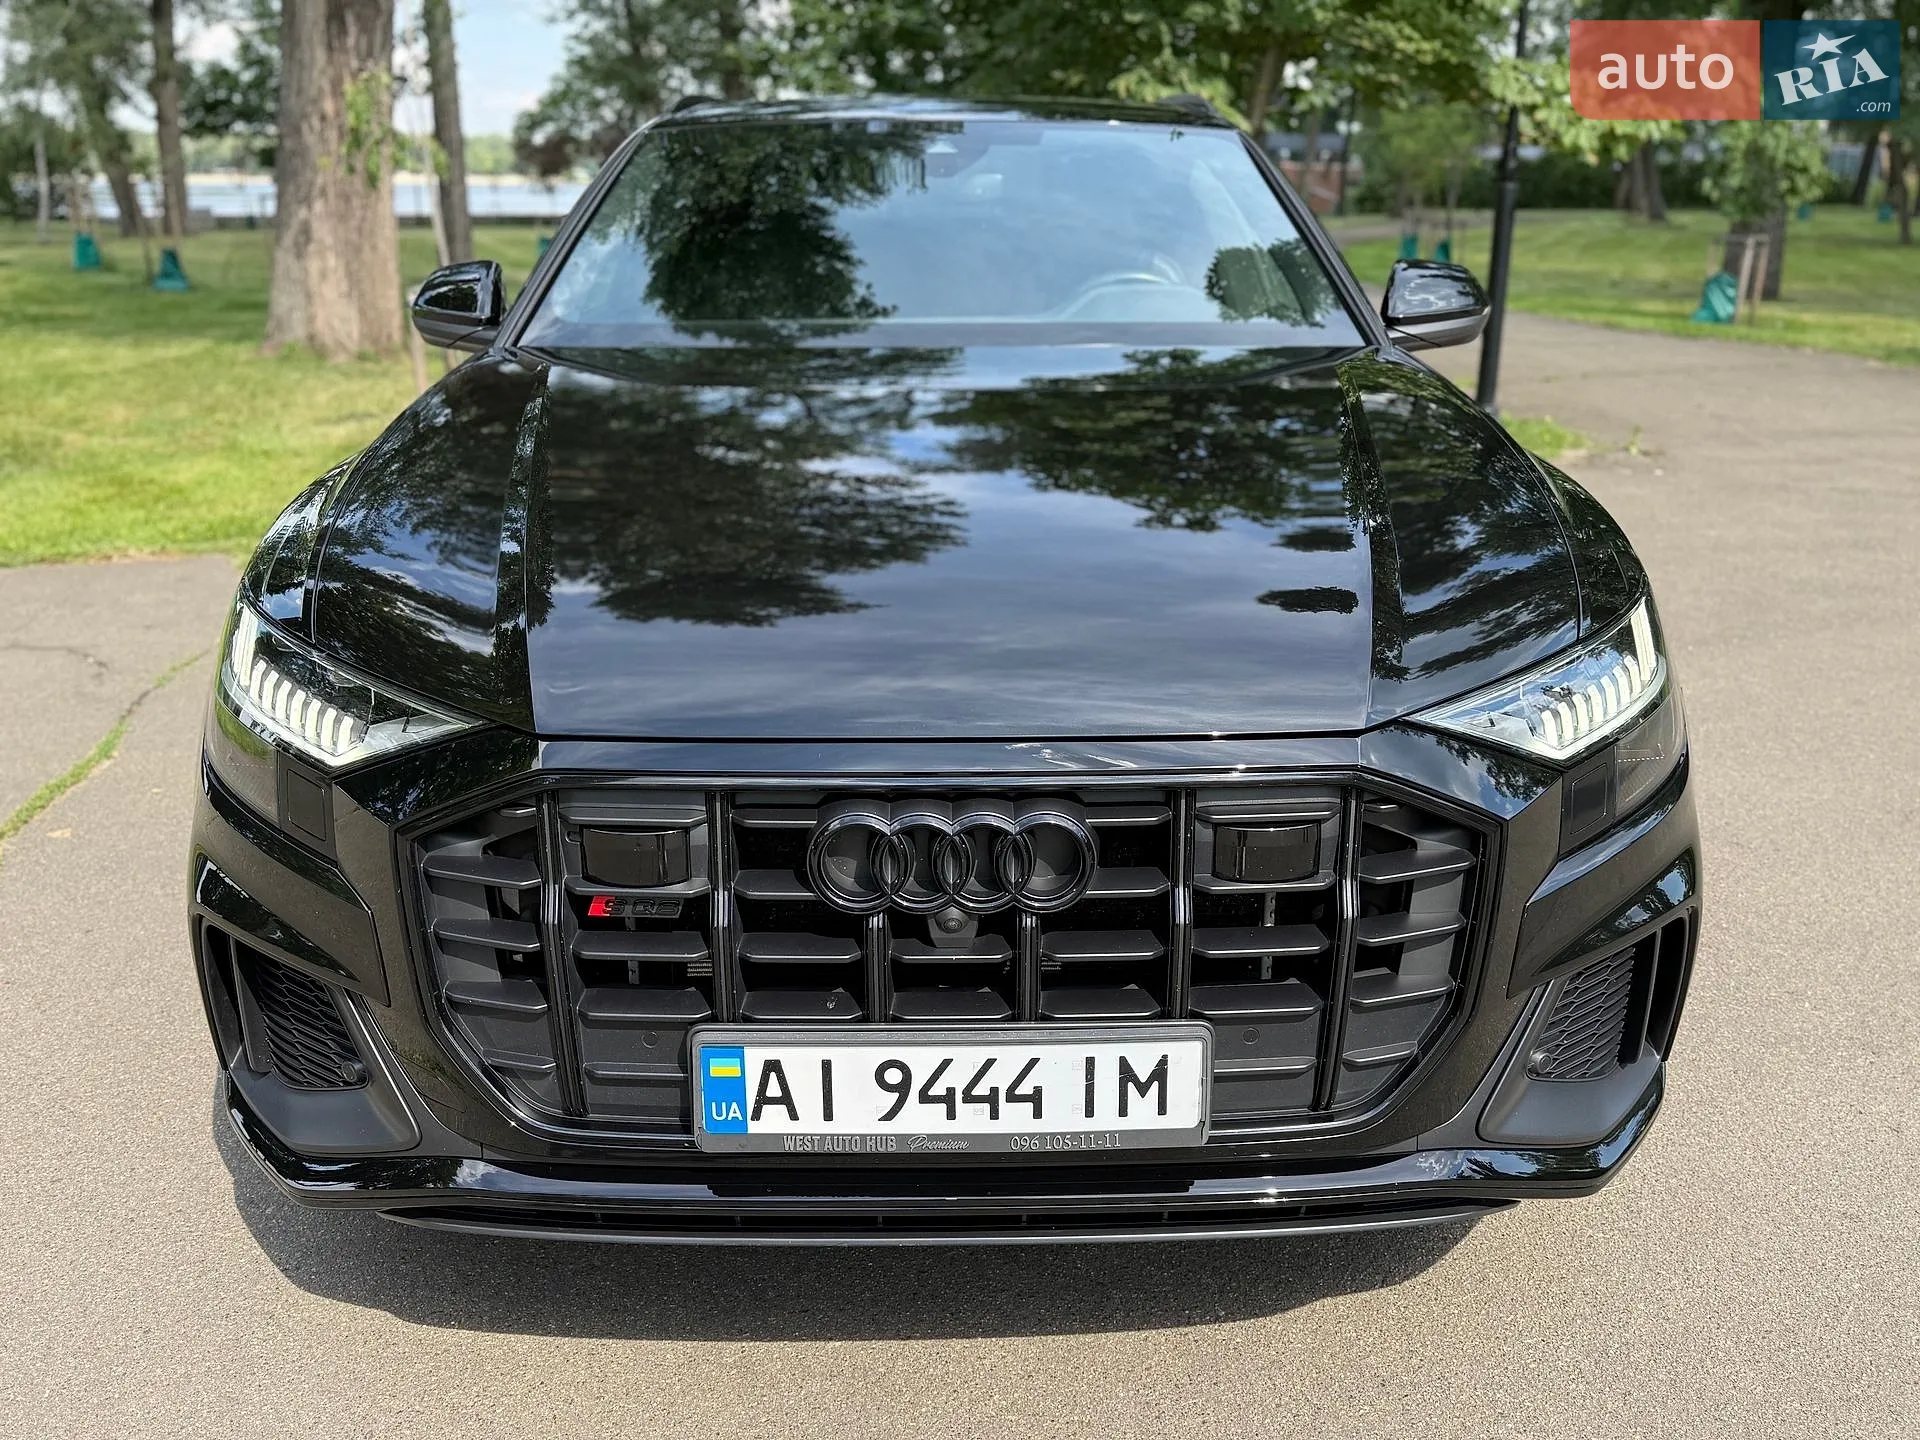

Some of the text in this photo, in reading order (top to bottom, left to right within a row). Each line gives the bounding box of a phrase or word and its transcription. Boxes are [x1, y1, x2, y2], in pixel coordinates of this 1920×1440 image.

[873, 1057, 1043, 1122] 9444
[1084, 1053, 1170, 1119] IM
[711, 1104, 743, 1121] UA
[783, 1132, 1122, 1153] WEST AUTO HUB Premium 096 105-11-11
